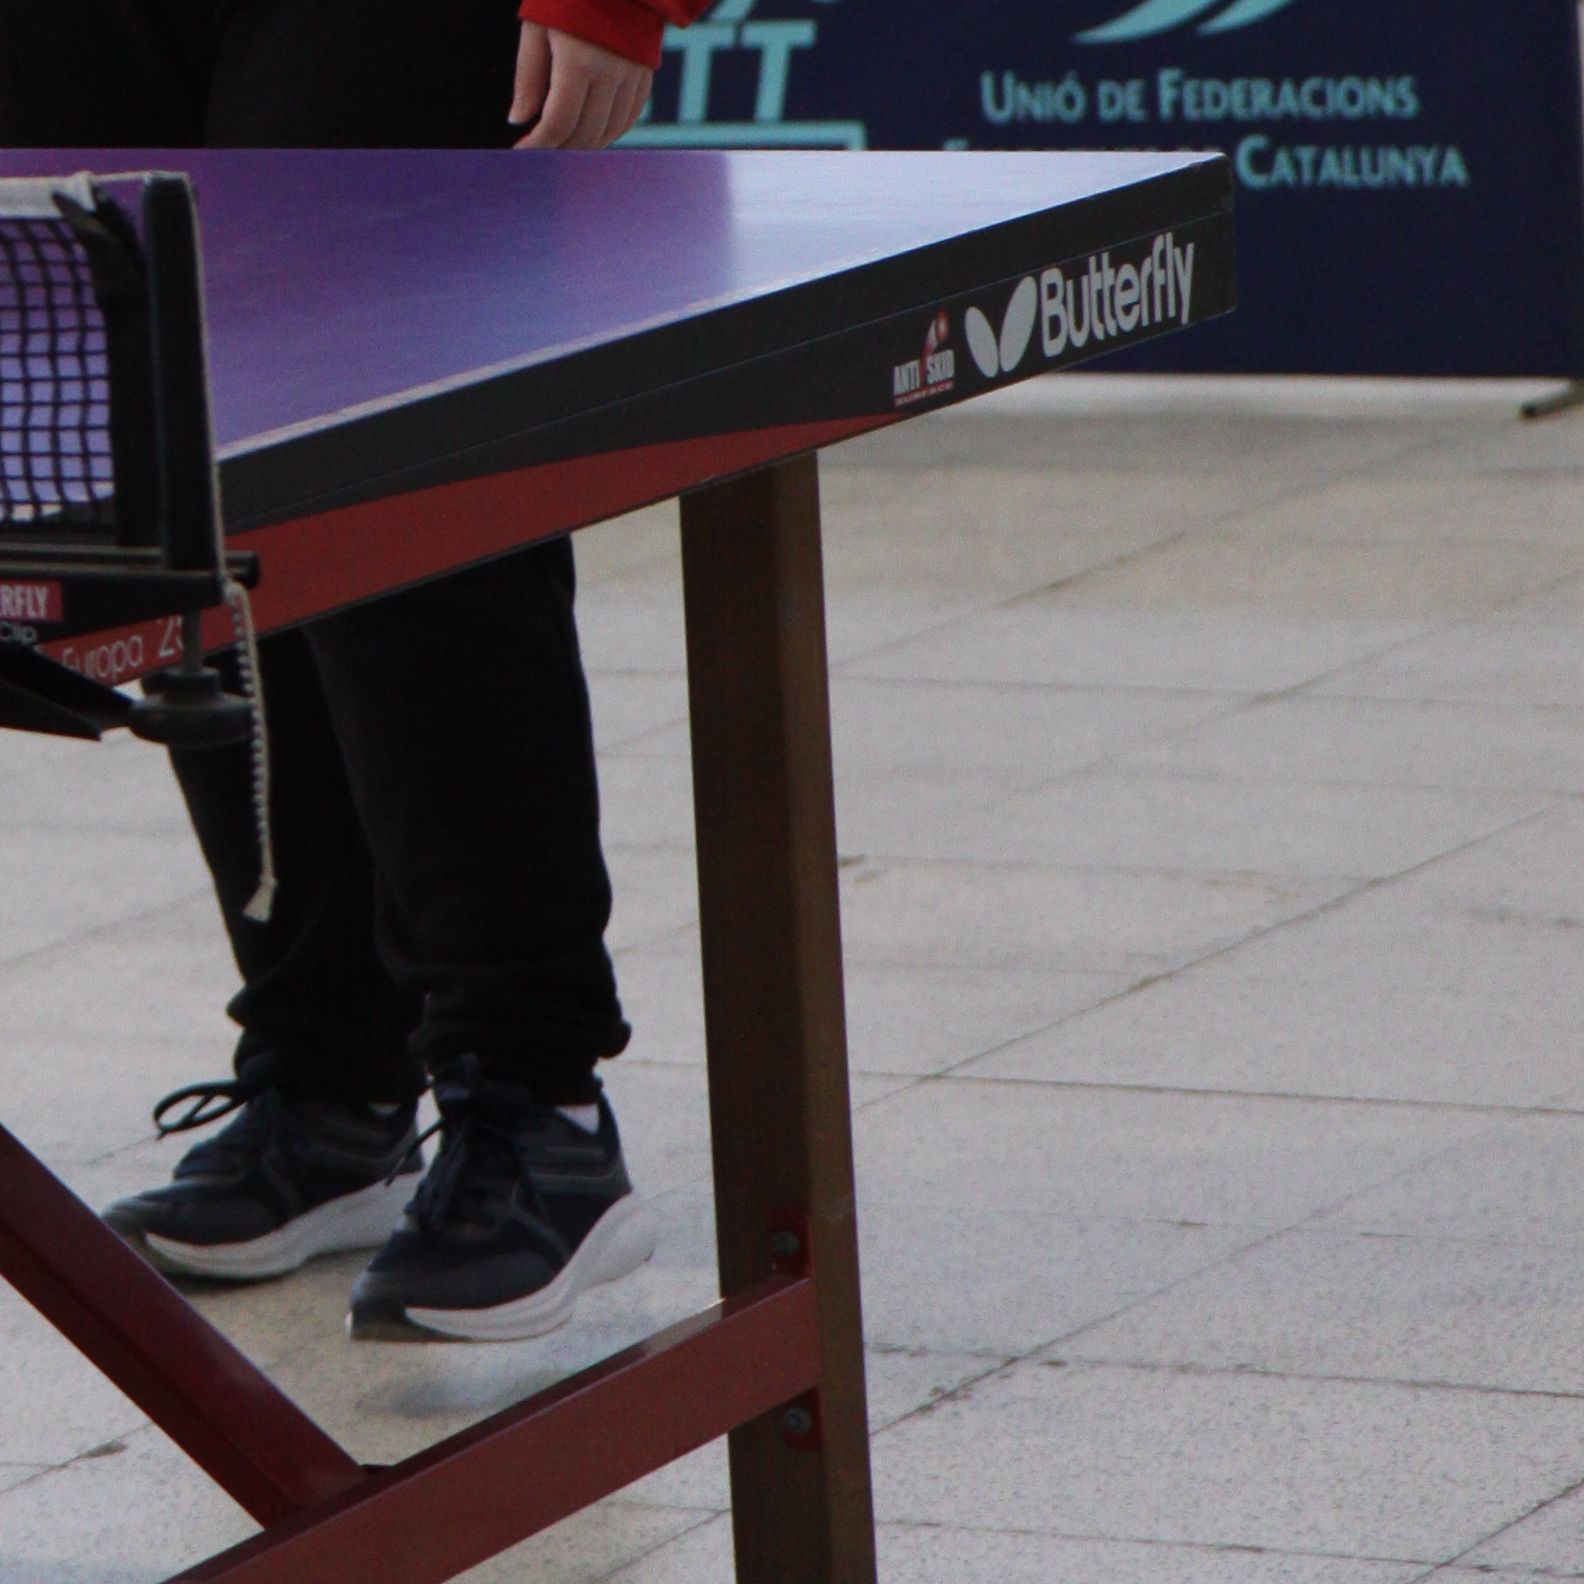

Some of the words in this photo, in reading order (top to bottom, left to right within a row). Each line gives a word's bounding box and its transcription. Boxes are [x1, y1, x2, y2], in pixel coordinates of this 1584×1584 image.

[1236, 134, 1470, 190] CATALUNYA
[1040, 231, 1195, 359] Butterfly
[893, 359, 921, 397] ANTI
[926, 349, 955, 385] SKID
